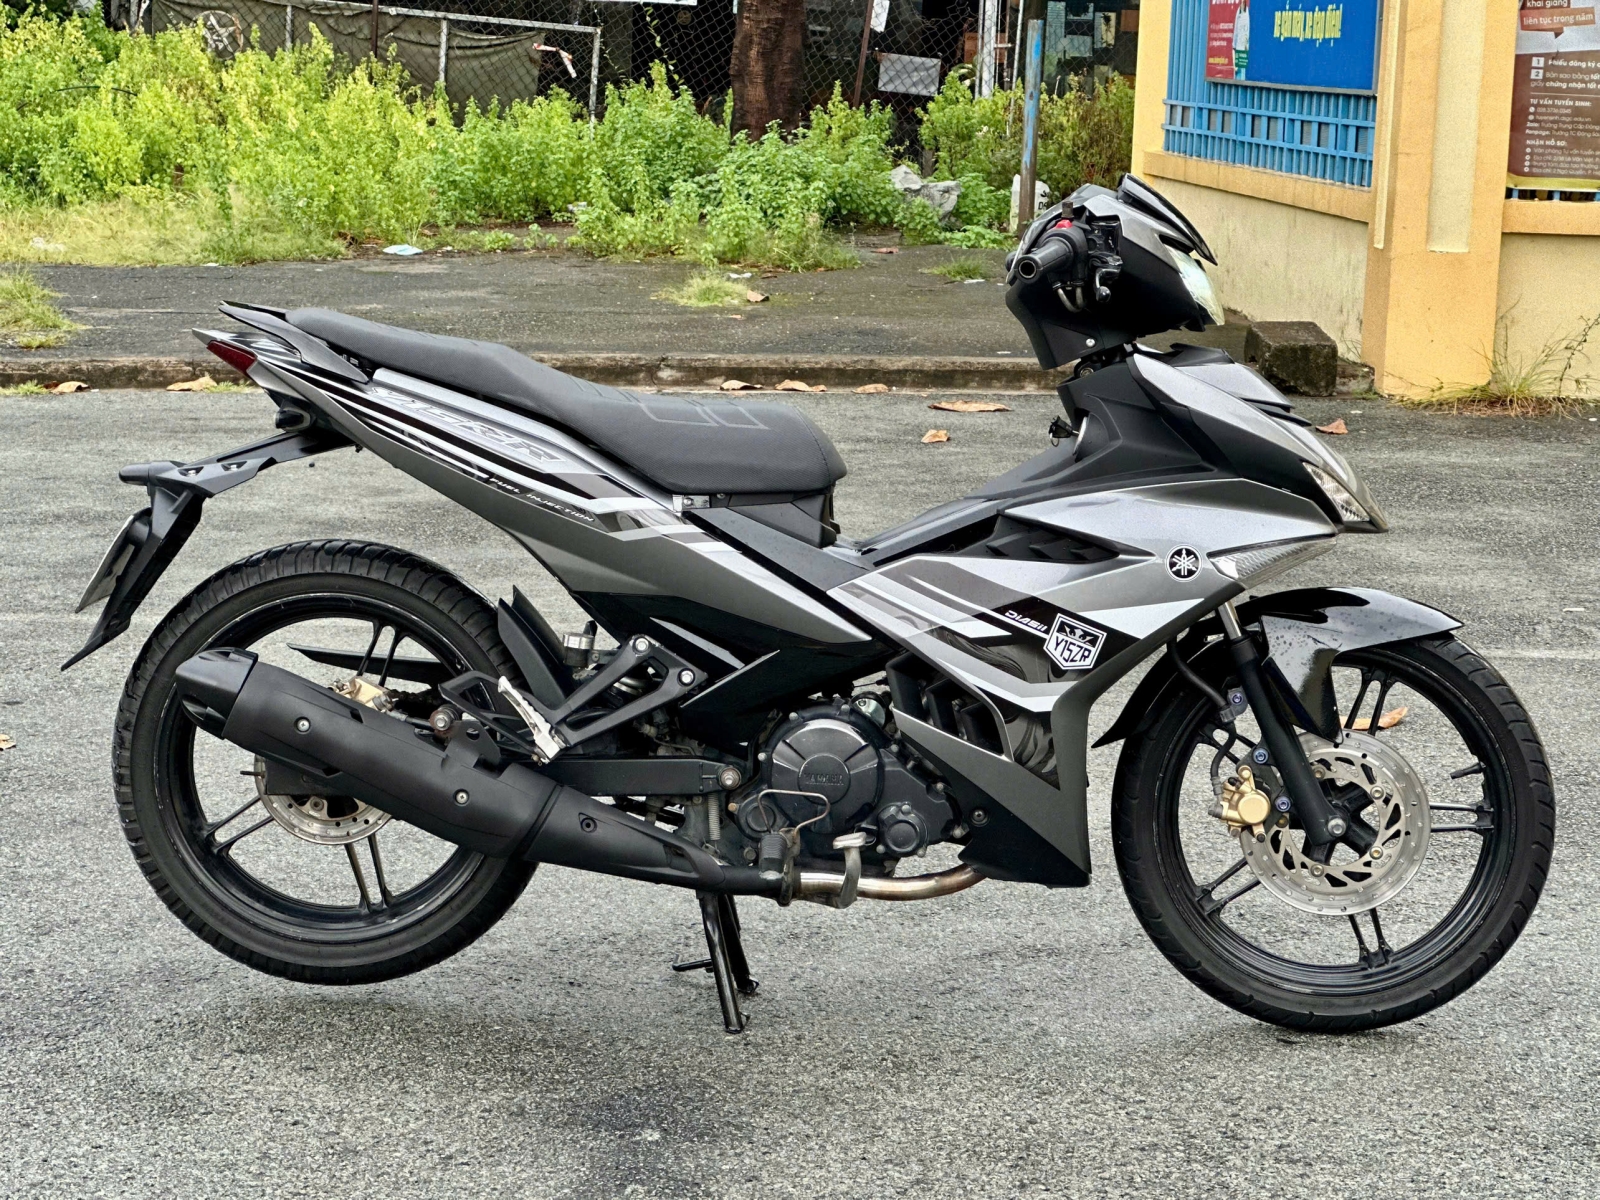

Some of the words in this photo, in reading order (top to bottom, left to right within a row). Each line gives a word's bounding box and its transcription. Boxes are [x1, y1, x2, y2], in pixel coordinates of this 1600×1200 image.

[1523, 17, 1538, 25] liên
[1540, 16, 1552, 24] tục
[1554, 15, 1574, 23] trong
[1568, 60, 1586, 68] đăng
[1545, 80, 1567, 89] chứng
[1587, 81, 1597, 89] tốt
[1539, 97, 1553, 105] VẤN
[489, 477, 521, 494] FUEL
[526, 493, 595, 523] INJECTION
[1054, 635, 1092, 663] Y15ZR
